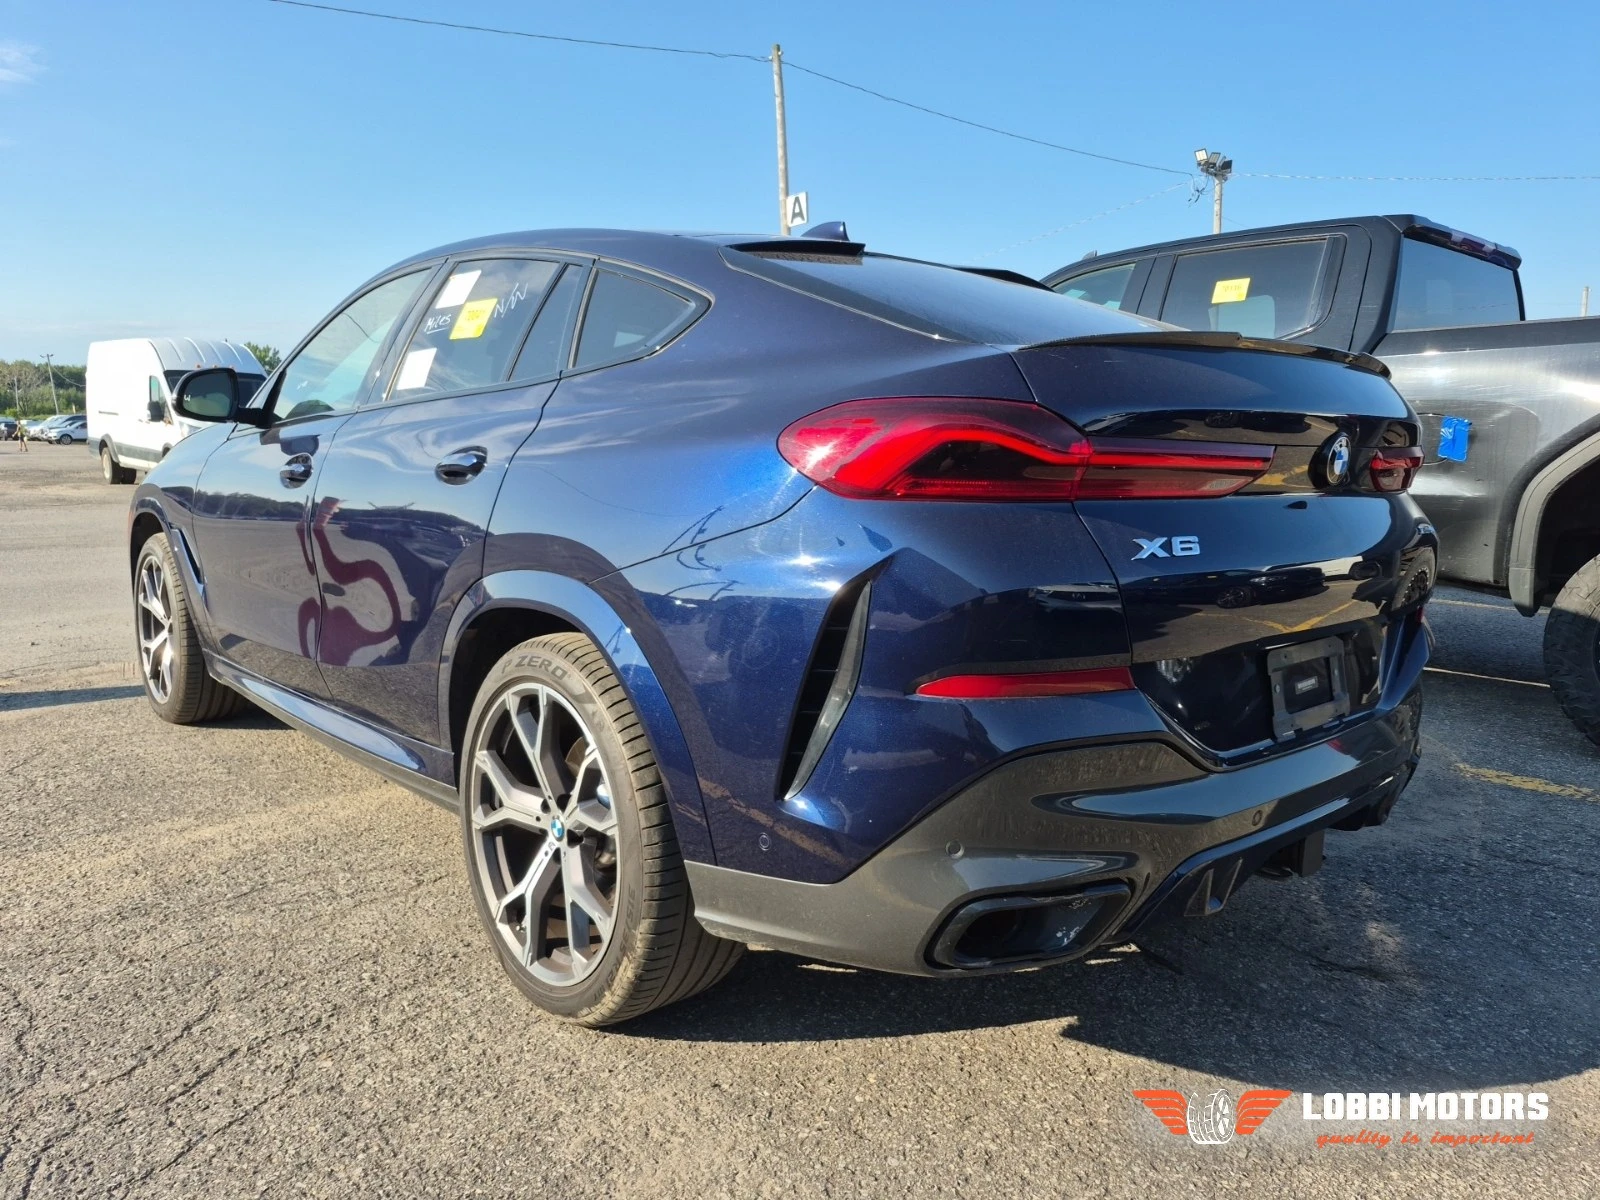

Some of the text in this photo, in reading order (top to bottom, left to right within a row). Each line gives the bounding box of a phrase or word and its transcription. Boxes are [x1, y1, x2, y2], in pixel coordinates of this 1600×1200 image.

[790, 196, 806, 224] A
[1130, 535, 1201, 561] X6
[501, 655, 568, 680] P ZERO
